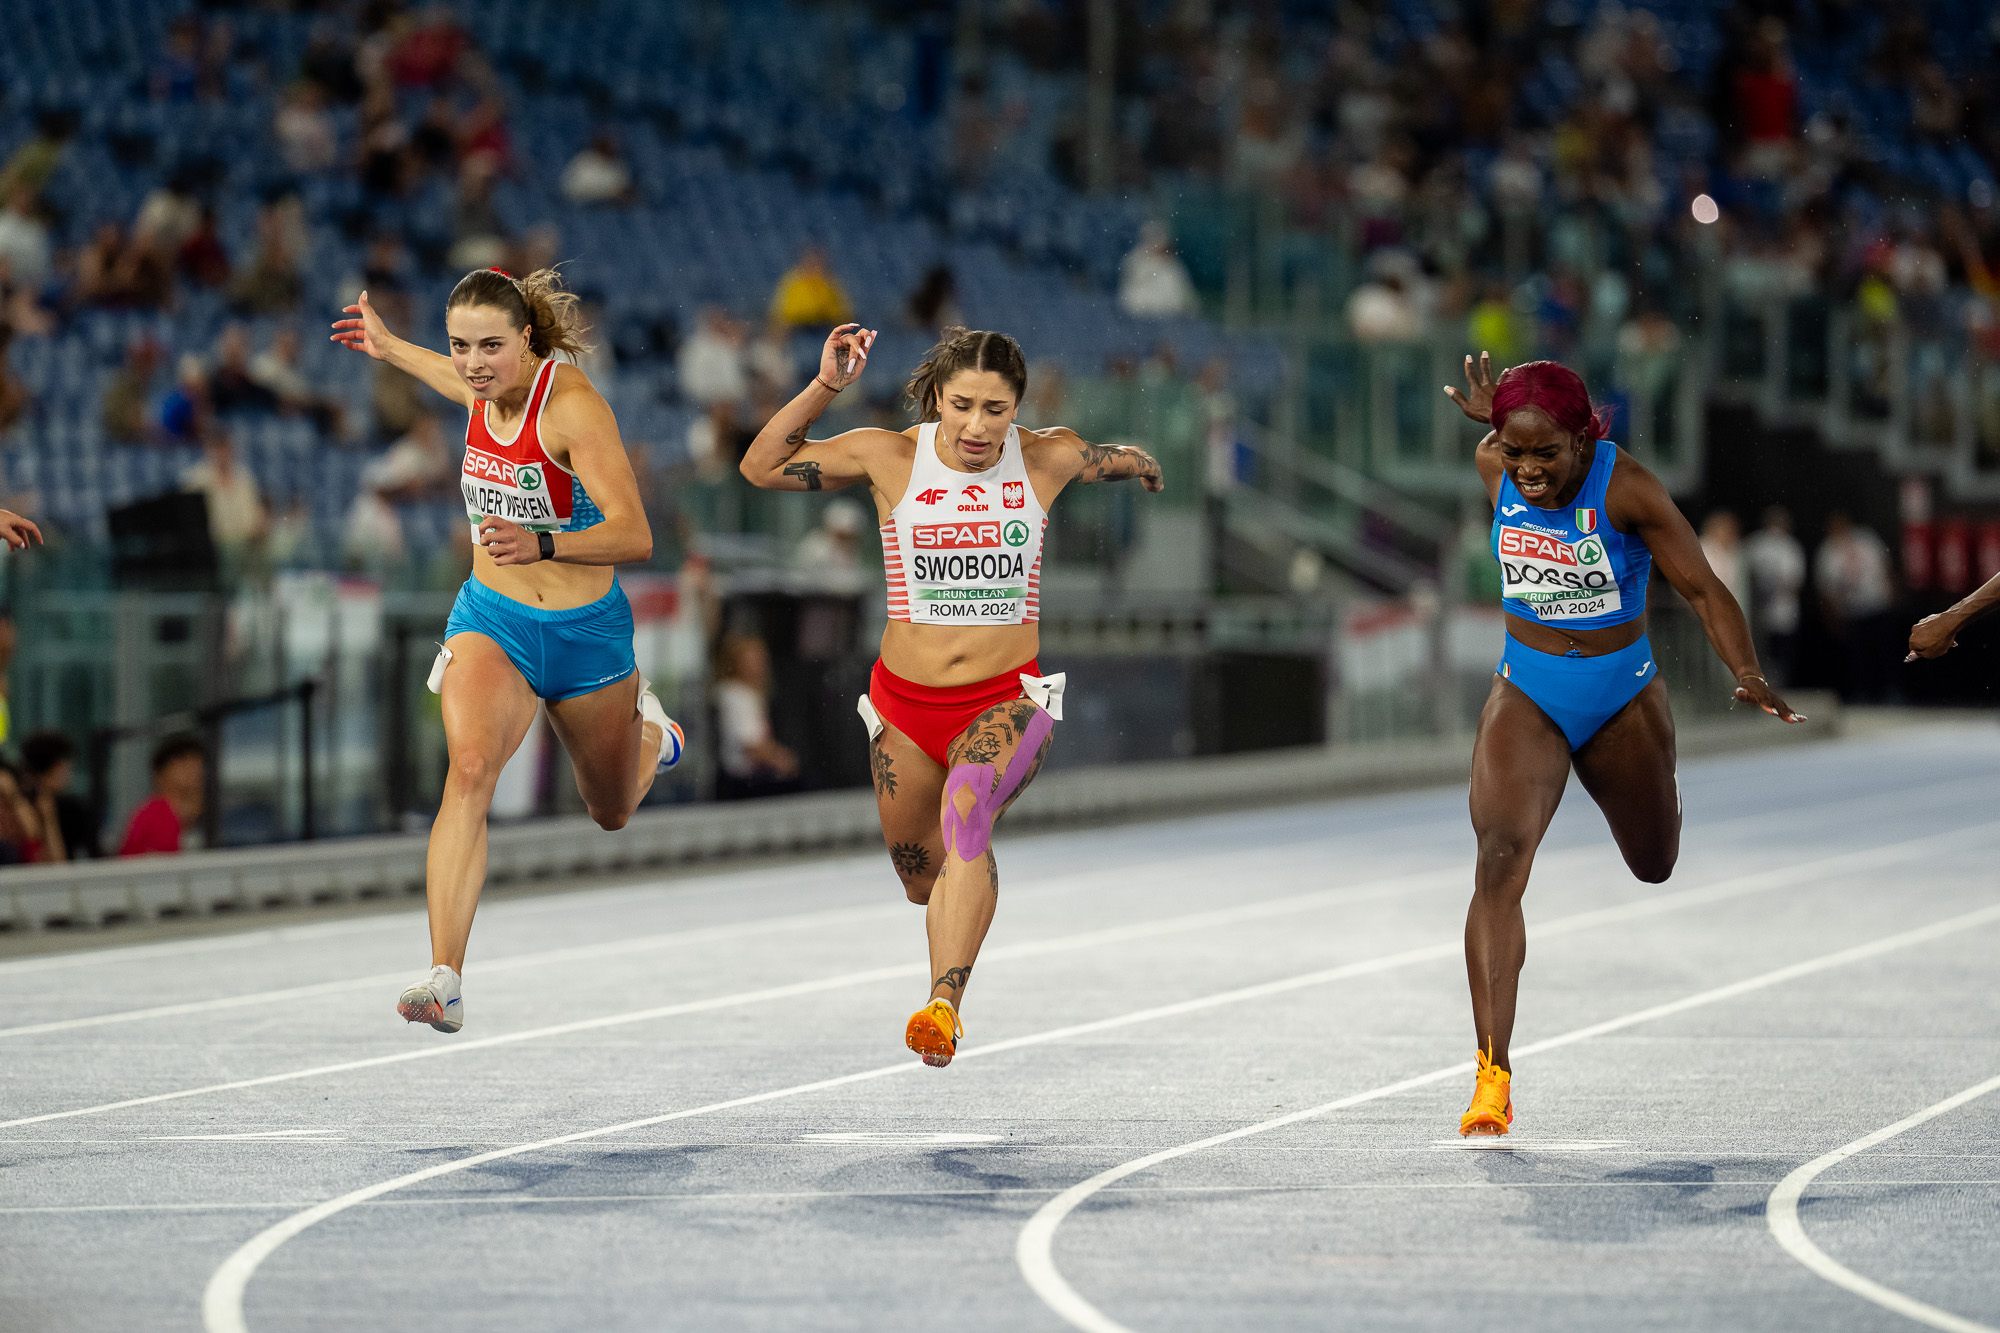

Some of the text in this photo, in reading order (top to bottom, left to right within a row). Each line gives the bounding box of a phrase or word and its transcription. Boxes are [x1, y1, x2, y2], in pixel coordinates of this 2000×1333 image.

[464, 452, 517, 485] SPAR
[479, 487, 503, 516] DER
[503, 492, 550, 520] WEKEN
[957, 504, 989, 512] ORLEN
[915, 524, 999, 546] SPAR
[1521, 521, 1568, 536] FRECCIAROSSA
[1502, 532, 1576, 563] SPAR
[914, 553, 1024, 581] SWOBODA
[1502, 561, 1608, 590] DOSSO
[937, 590, 941, 599] I
[943, 590, 967, 599] RUN
[1530, 593, 1553, 602] RUN
[1556, 589, 1593, 600] CLEAN
[930, 602, 1016, 617] ROMA 2024
[1568, 598, 1606, 614] 2024
